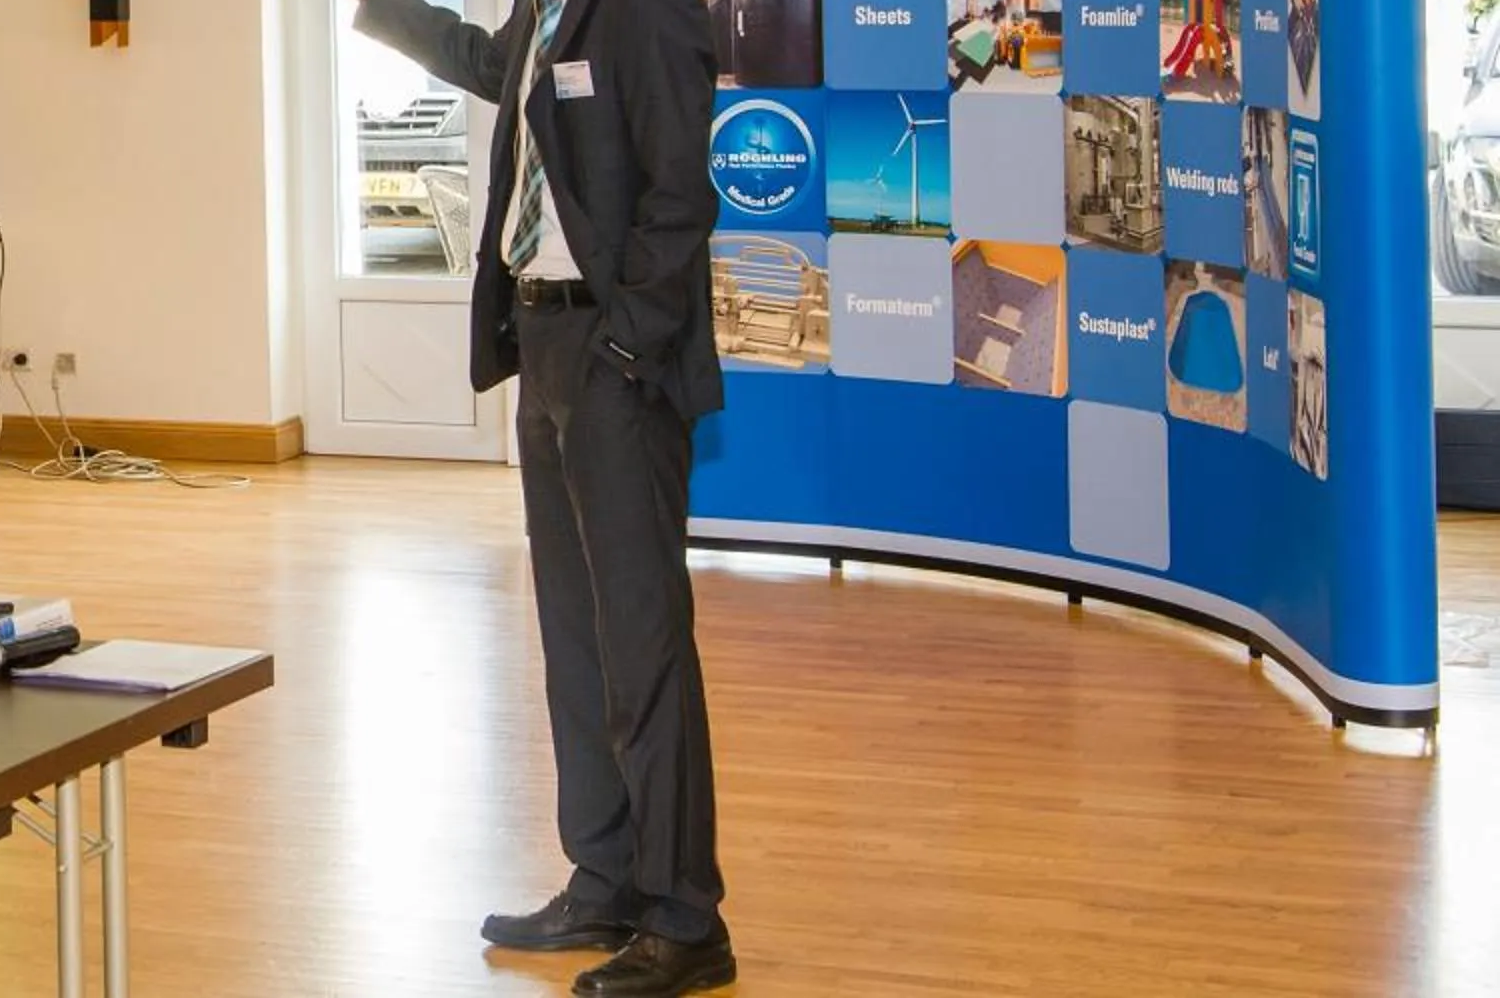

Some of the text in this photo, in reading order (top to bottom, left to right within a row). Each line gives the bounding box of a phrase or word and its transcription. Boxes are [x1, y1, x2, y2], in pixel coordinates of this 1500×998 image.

[855, 5, 911, 25] Sheets
[1166, 167, 1239, 197] Welding rods
